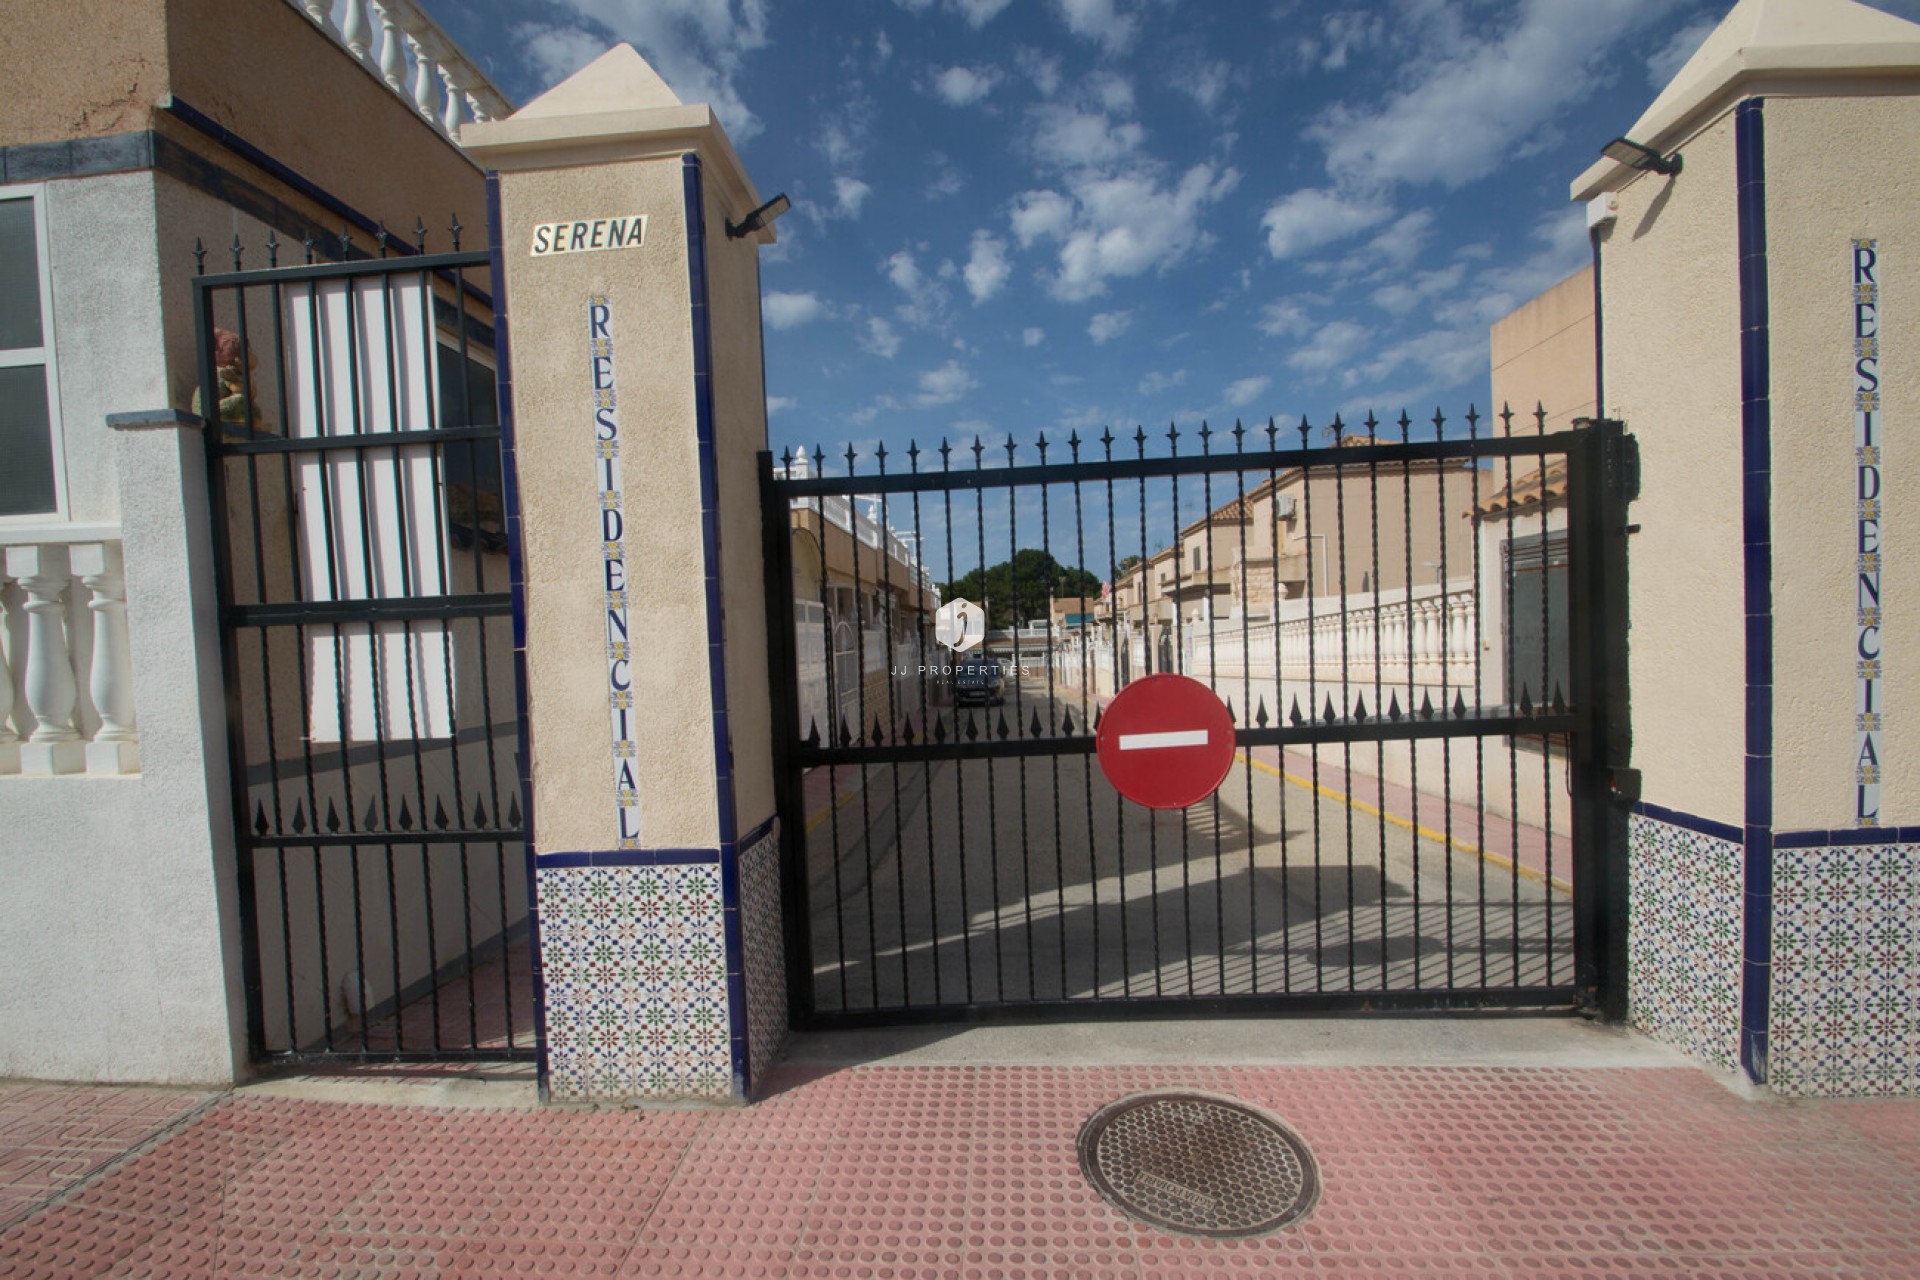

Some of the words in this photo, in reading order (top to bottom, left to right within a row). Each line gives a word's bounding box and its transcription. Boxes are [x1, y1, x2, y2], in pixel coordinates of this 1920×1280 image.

[534, 218, 643, 253] SERENA
[590, 304, 640, 840] RESIDENCIAL
[1854, 247, 1881, 819] RESIDENCIAL
